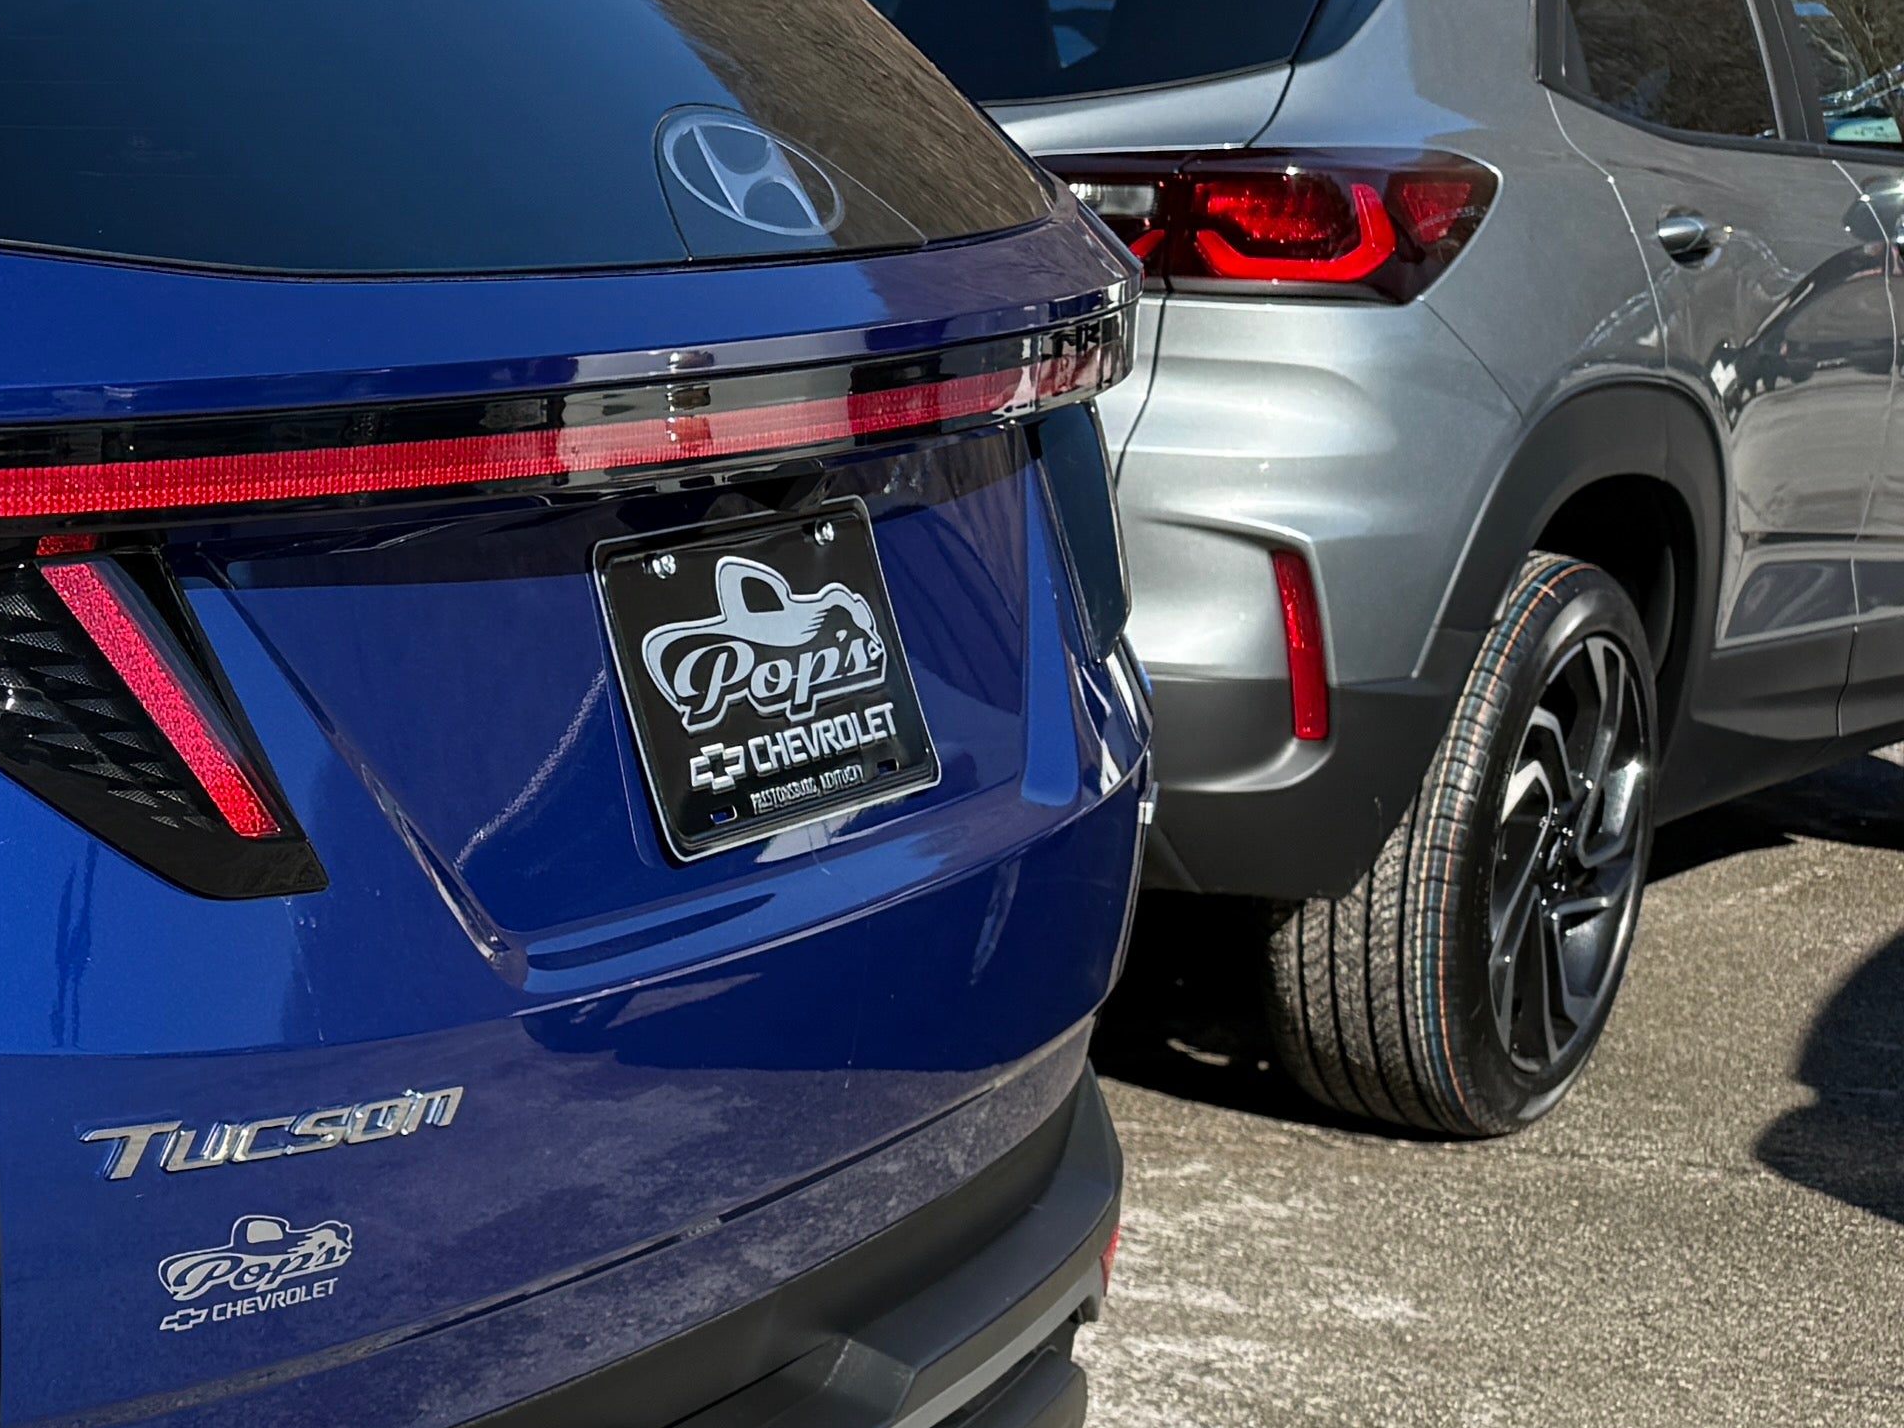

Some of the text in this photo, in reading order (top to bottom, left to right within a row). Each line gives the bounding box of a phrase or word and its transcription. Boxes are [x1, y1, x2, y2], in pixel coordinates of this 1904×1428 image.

[673, 629, 878, 716] Pop's
[748, 702, 896, 774] CHEVROLET
[212, 1277, 339, 1322] CHEVROLET
